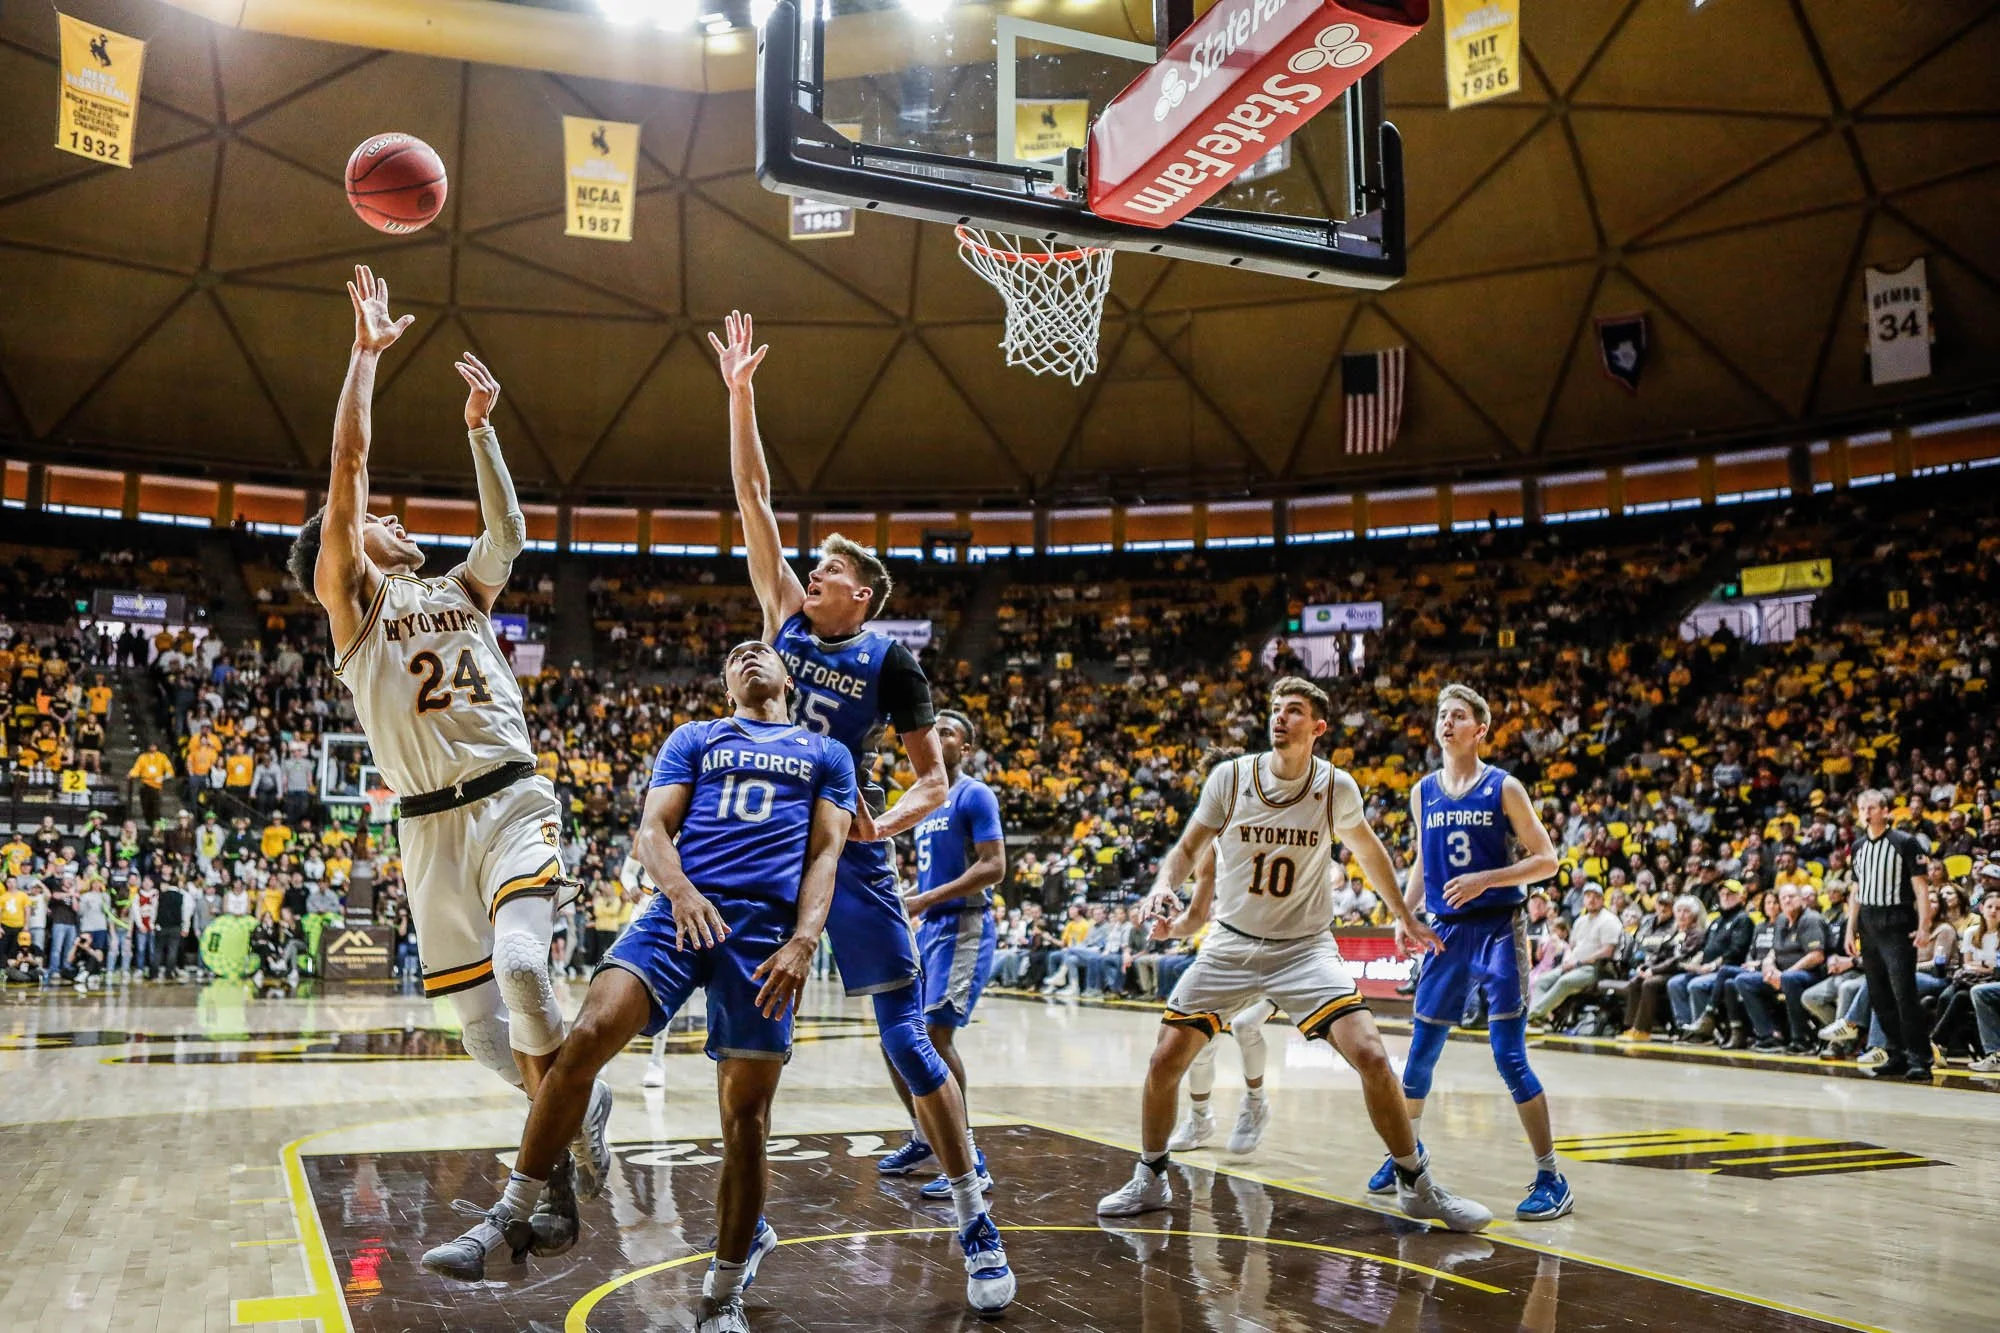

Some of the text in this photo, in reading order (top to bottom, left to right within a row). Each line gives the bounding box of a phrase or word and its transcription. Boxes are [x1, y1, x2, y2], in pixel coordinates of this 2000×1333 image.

[1468, 34, 1498, 58] NIT
[1462, 67, 1508, 97] 1986
[70, 131, 120, 160] 1932
[577, 185, 620, 203] NCAA
[577, 215, 621, 233] 1987
[1879, 309, 1921, 341] 34
[382, 609, 479, 642] WYOMING
[407, 646, 494, 717] 24
[801, 659, 867, 700] FORCE
[69, 774, 81, 790] 2
[702, 749, 813, 783] AIR FORCE
[716, 774, 777, 824] 10
[1426, 810, 1493, 830] AIR FORCE
[1240, 826, 1319, 847] WYOMING
[1447, 830, 1472, 867] 3
[917, 837, 932, 873] 5
[1248, 851, 1296, 898] 10
